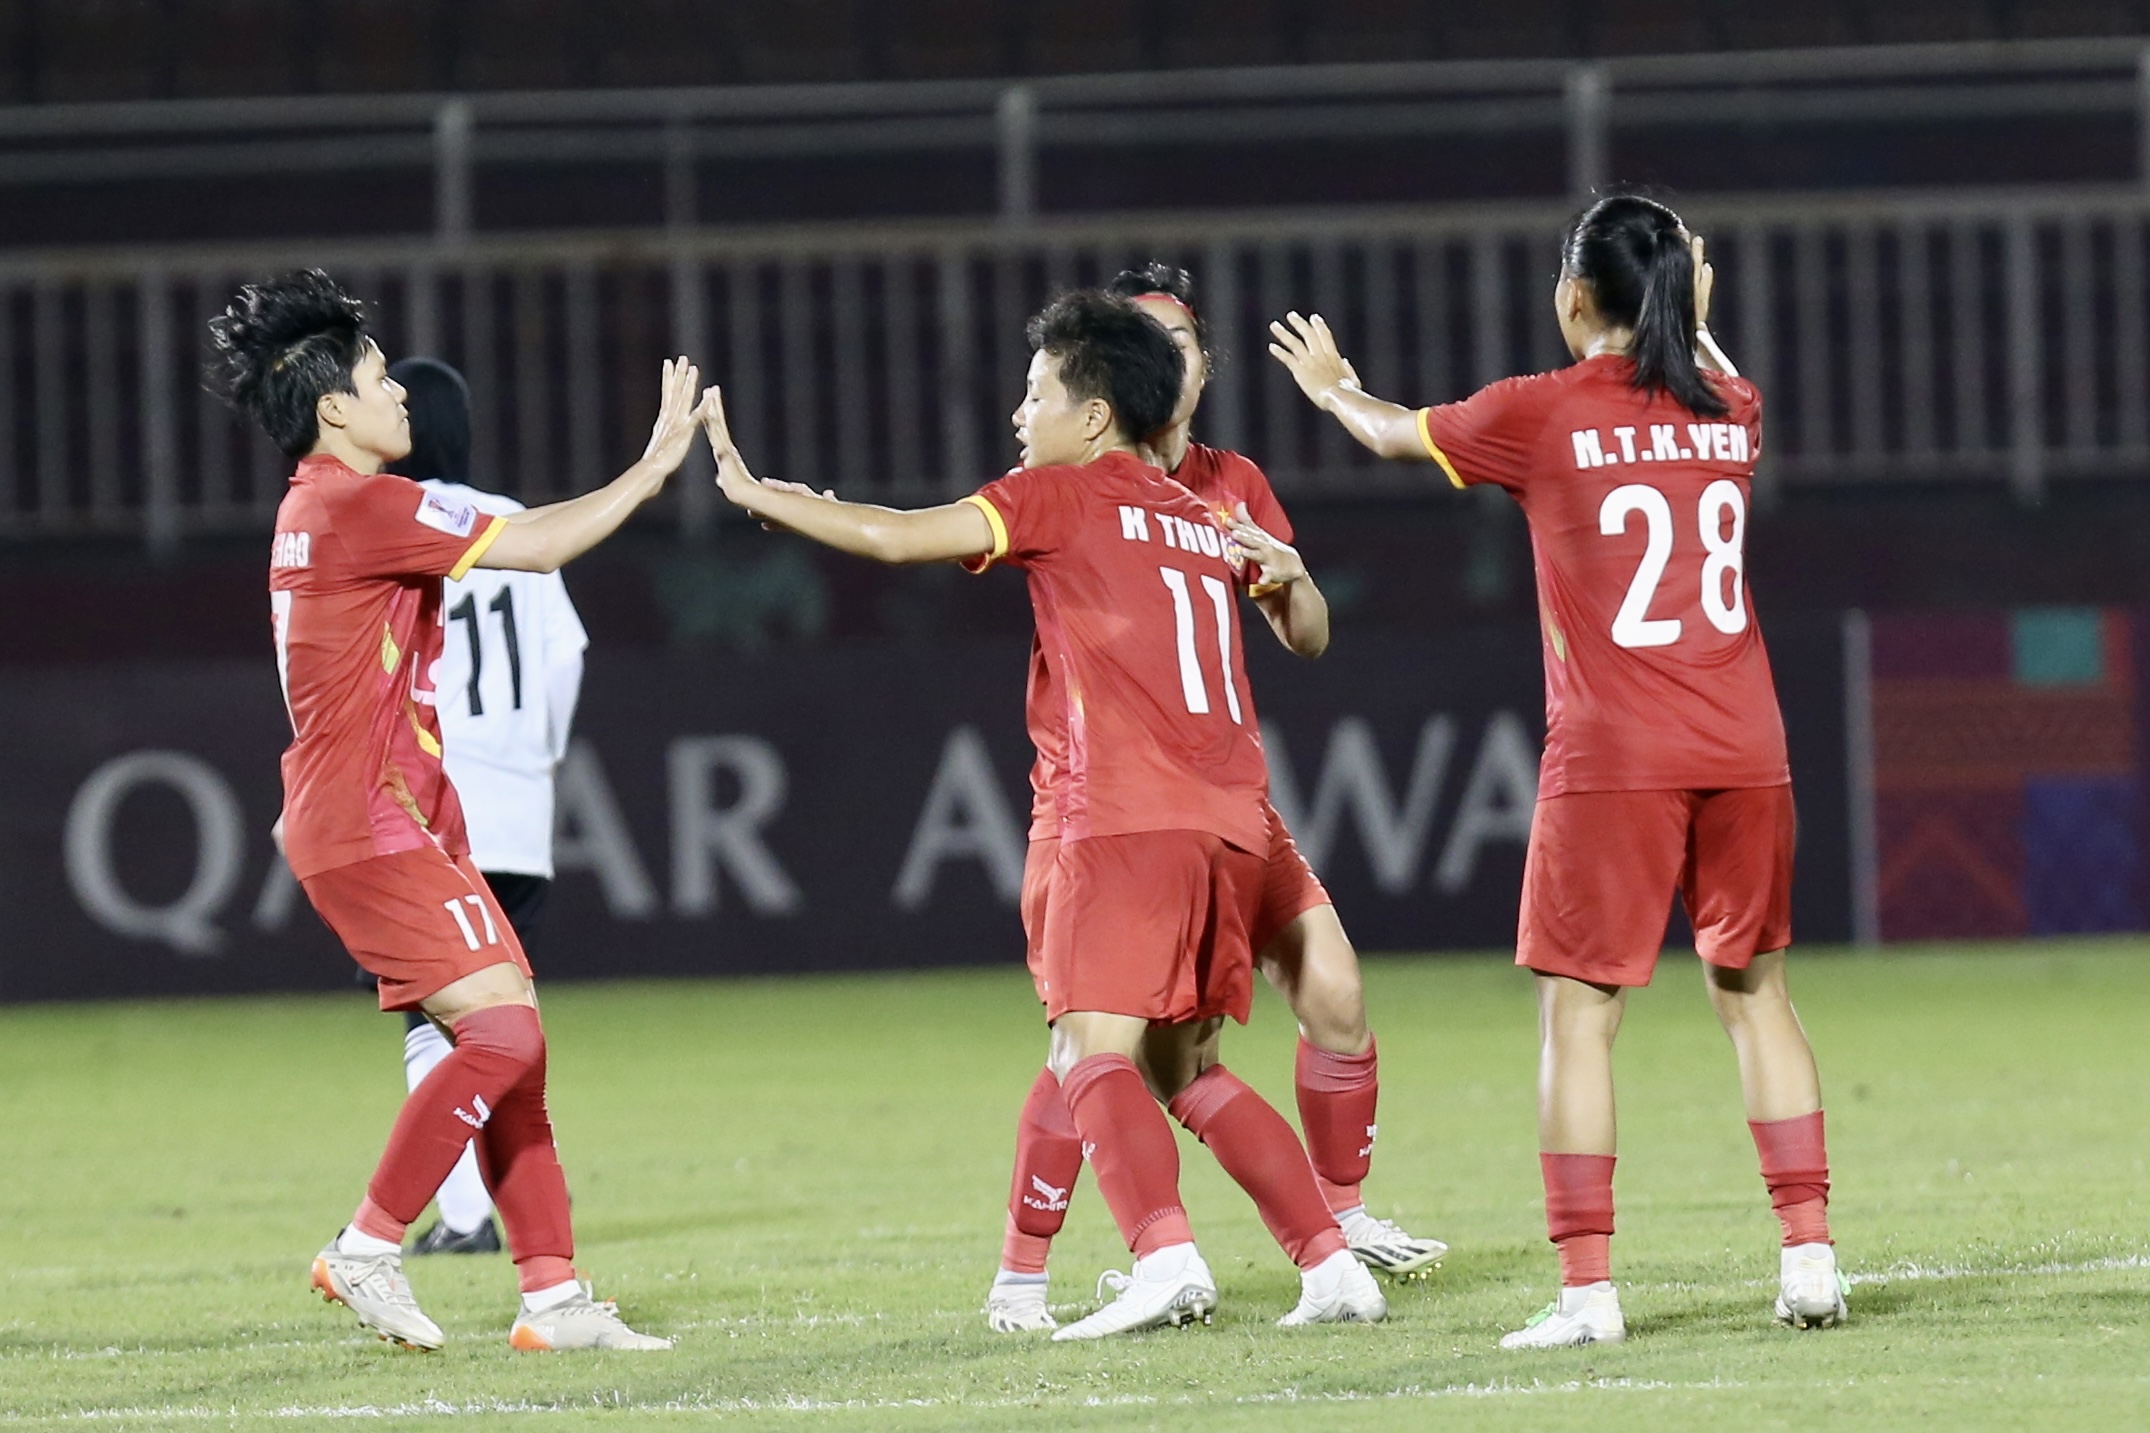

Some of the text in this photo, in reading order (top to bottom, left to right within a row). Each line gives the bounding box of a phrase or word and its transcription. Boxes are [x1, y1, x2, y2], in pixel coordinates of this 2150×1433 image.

[1571, 423, 1749, 469] N.T.K.YEN
[1118, 505, 1150, 542] K
[1599, 479, 1748, 648] 28
[448, 583, 521, 716] 11
[1158, 566, 1242, 725] 11
[64, 735, 800, 952] QAR
[444, 894, 498, 951] 17
